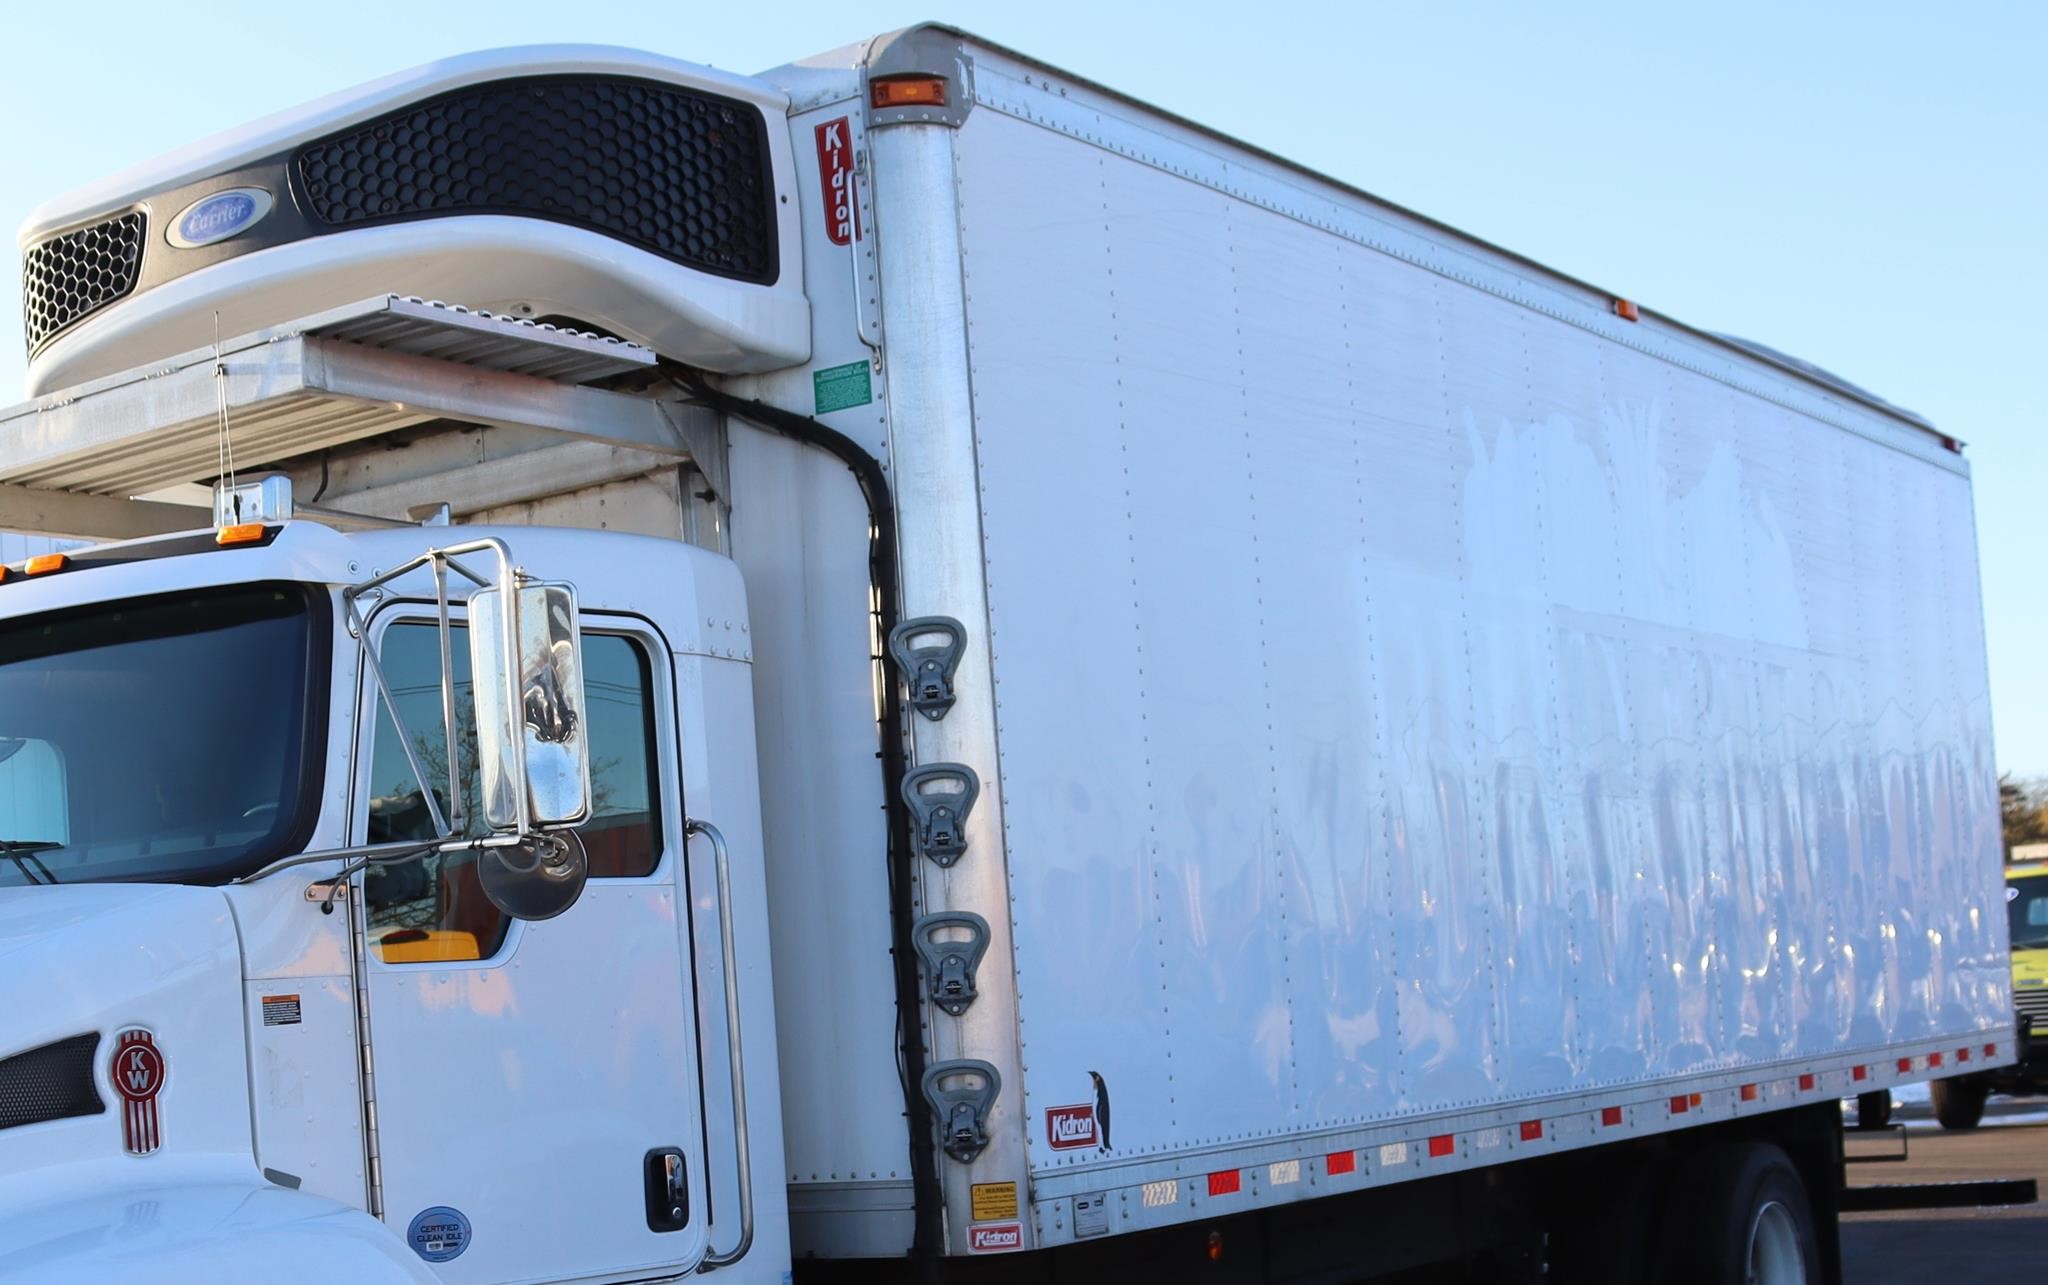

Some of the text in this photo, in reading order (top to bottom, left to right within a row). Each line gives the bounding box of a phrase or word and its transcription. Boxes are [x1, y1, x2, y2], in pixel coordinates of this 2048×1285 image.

[825, 123, 850, 238] Kidron
[188, 203, 246, 233] Carrier
[1052, 1114, 1093, 1142] Kidron
[416, 1232, 463, 1243] CLEAN IDLE
[420, 1223, 459, 1233] CERTIFIED
[975, 1231, 1017, 1247] Kidron
